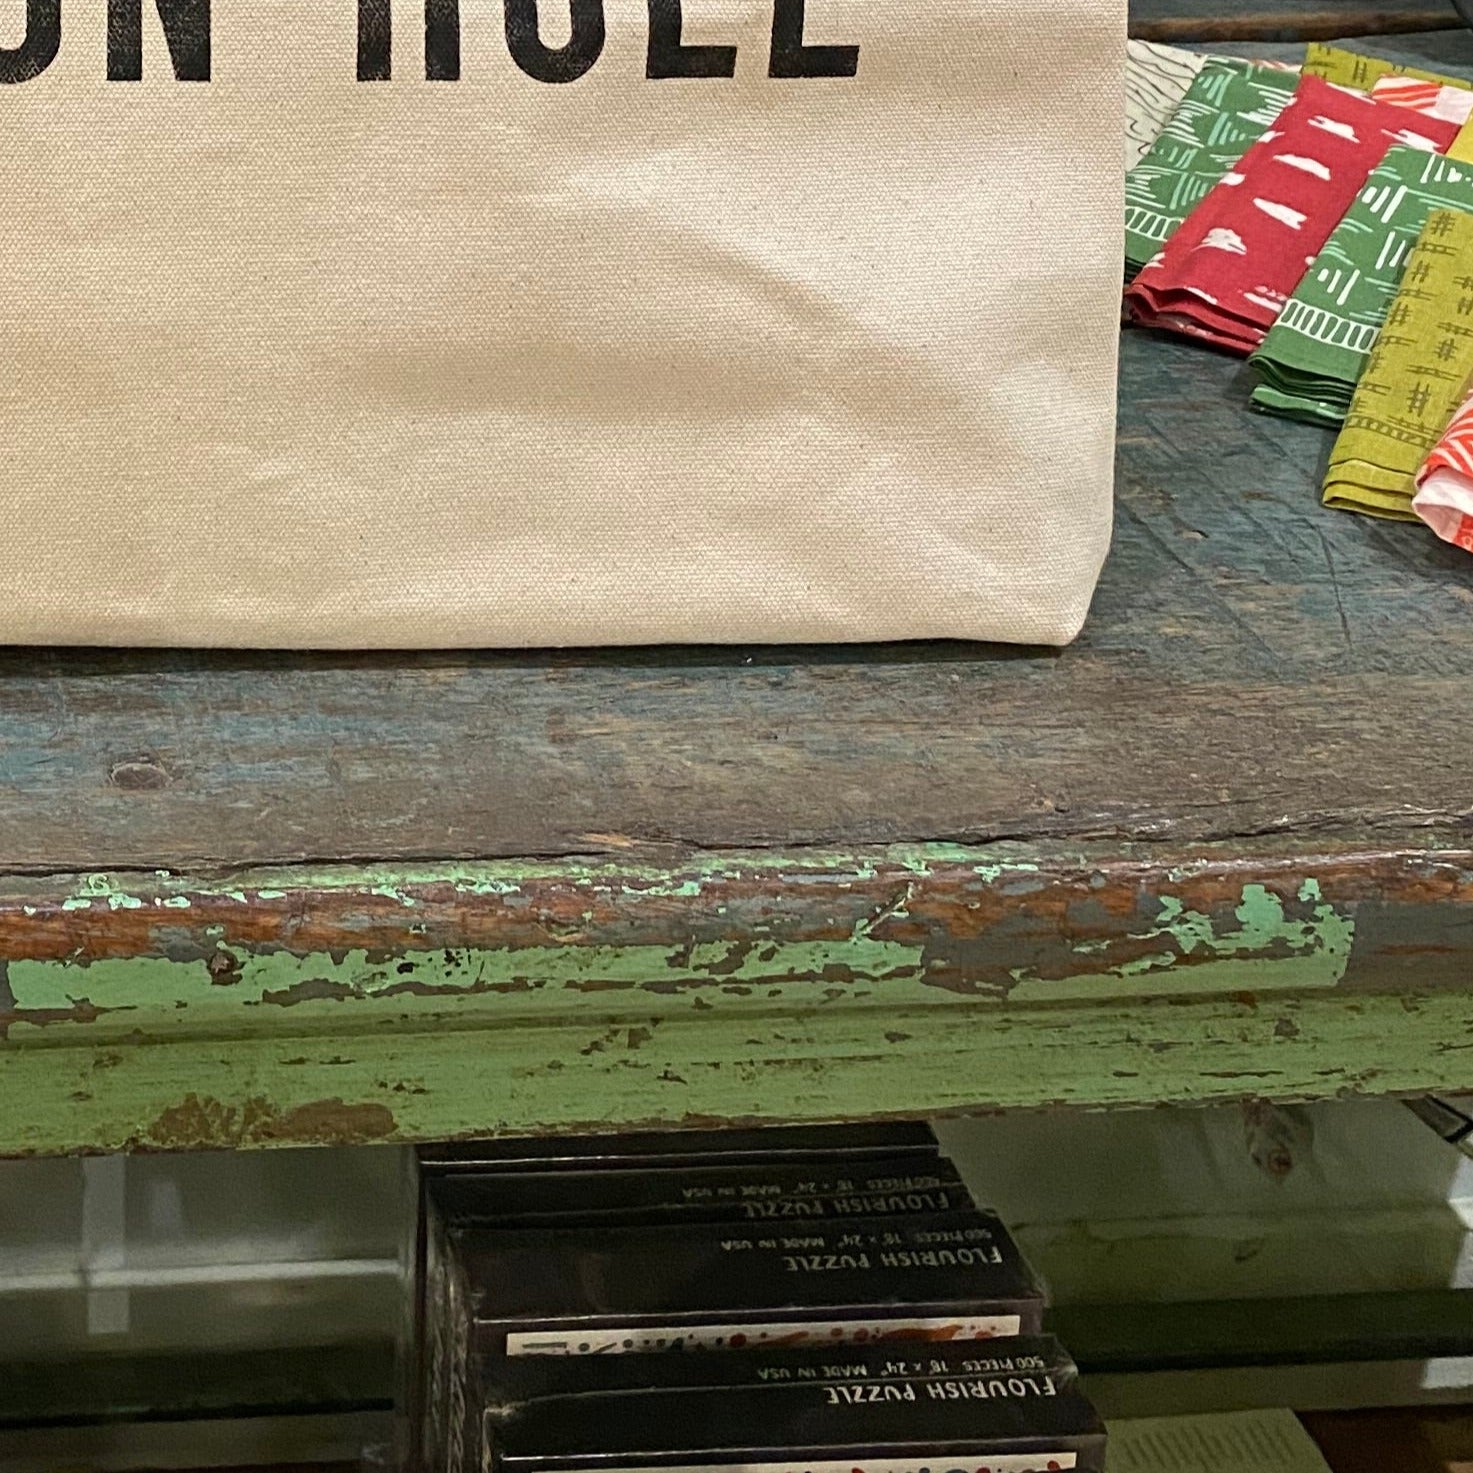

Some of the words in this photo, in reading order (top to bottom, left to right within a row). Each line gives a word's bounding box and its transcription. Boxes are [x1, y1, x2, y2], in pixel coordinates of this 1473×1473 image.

[741, 1199, 824, 1218] PUZZLE
[833, 1192, 950, 1214] FLOURISH
[720, 1240, 753, 1251] USA
[758, 1239, 777, 1249] IN
[780, 1237, 825, 1249] MADE
[781, 1253, 871, 1272] PUZZLE
[880, 1246, 1002, 1267] FLOURISH
[962, 1357, 1013, 1372] PIECES
[1015, 1355, 1044, 1369] 500
[757, 1367, 790, 1380] USA
[798, 1367, 816, 1378] IN
[824, 1365, 867, 1377] MADE
[824, 1383, 916, 1405] PUZZLE
[927, 1376, 1056, 1400] FLOURISH
